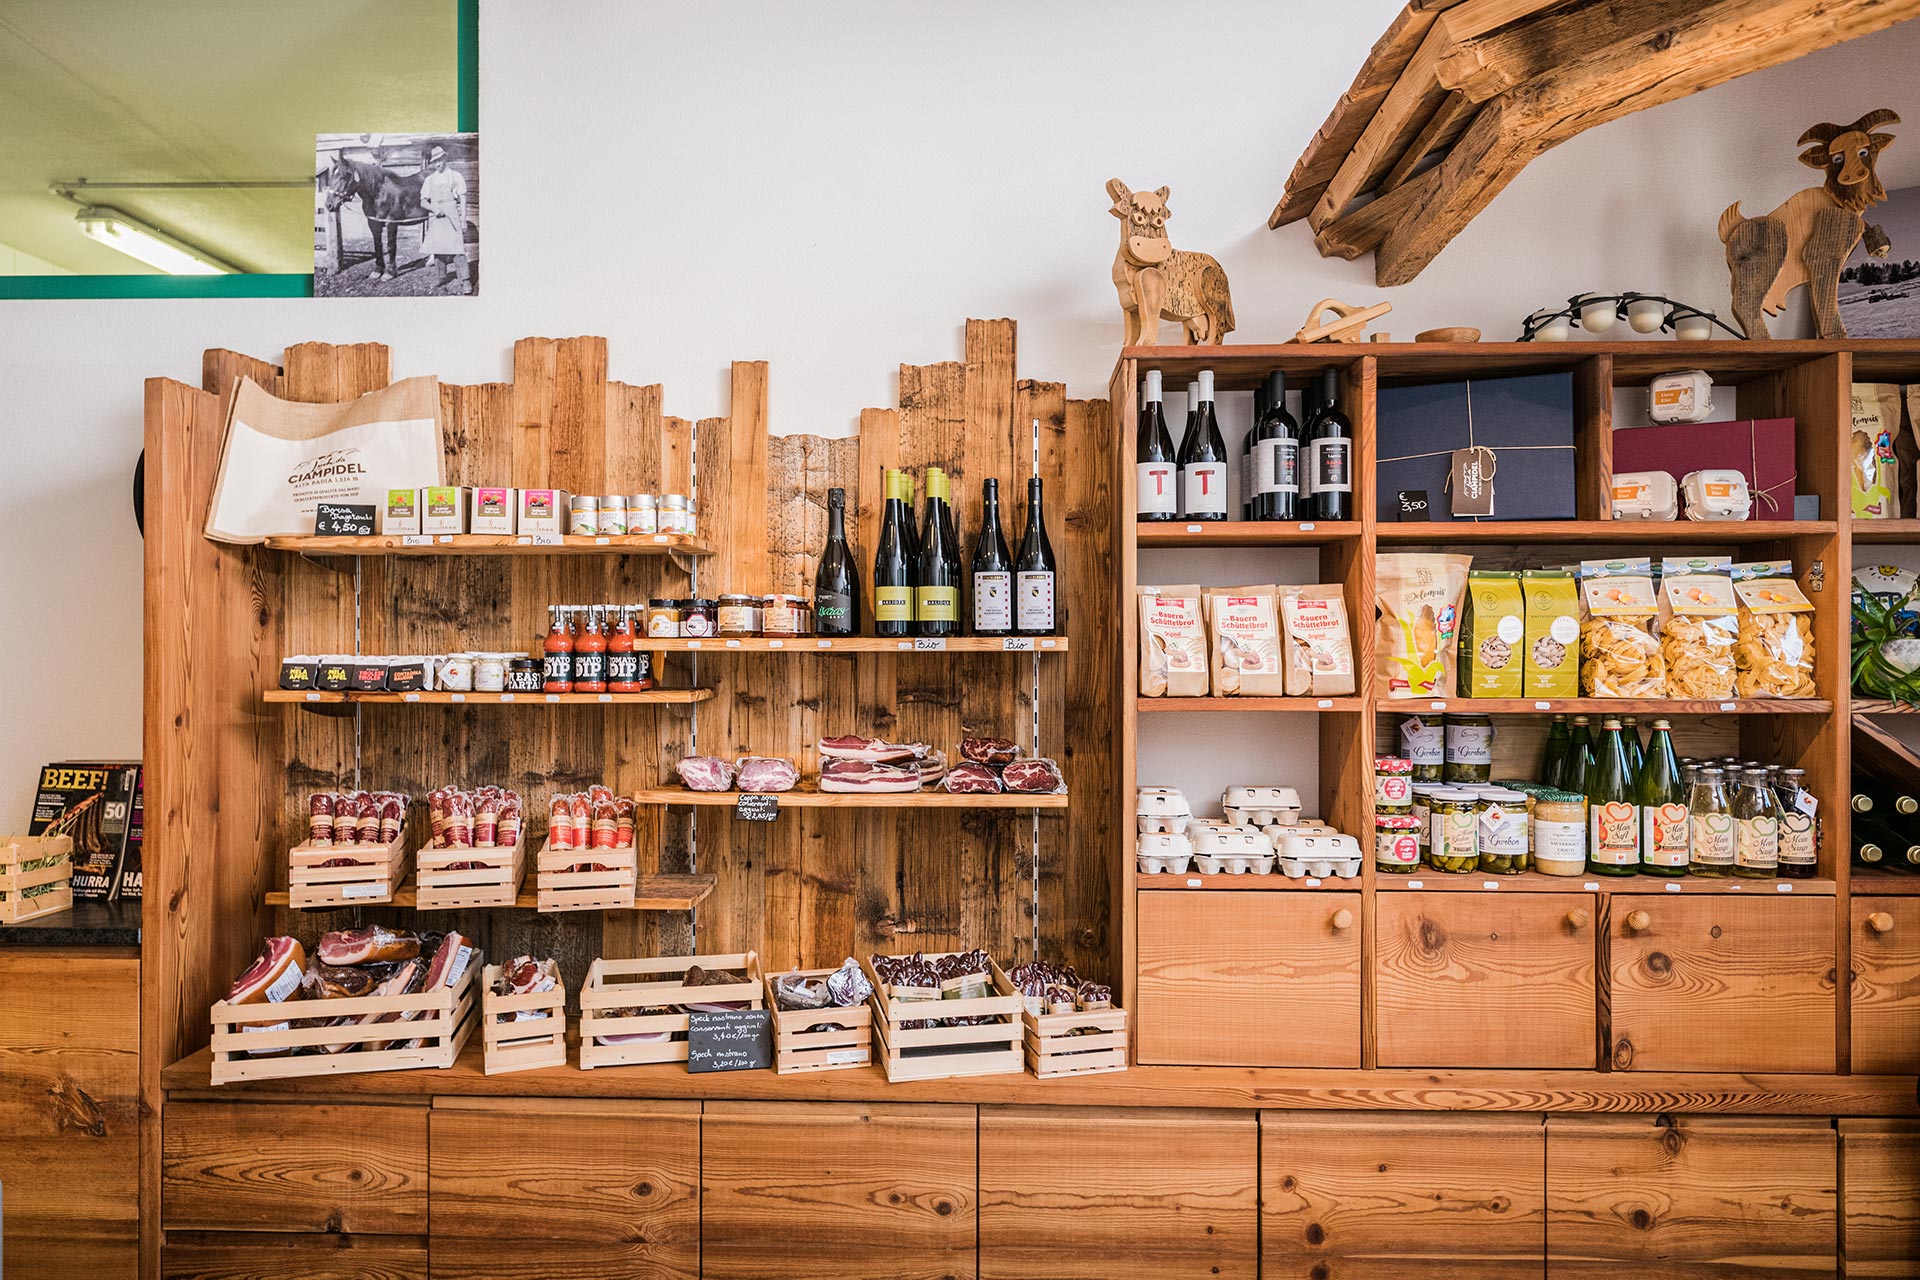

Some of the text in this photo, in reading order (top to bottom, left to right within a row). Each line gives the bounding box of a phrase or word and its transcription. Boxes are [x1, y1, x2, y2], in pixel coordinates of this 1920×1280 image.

[288, 463, 366, 484] CIAMPIDEL
[1148, 470, 1168, 496] T
[1194, 470, 1215, 496] T
[1399, 492, 1408, 501] €
[1401, 500, 1428, 512] 3,50
[318, 520, 358, 533] € 4,50
[406, 536, 420, 544] Bio
[536, 535, 552, 544] Bio
[1150, 617, 1194, 626] Schüttelbrot
[1158, 612, 1184, 620] Bauern
[1300, 614, 1328, 622] Bauern
[1293, 620, 1340, 628] Schüttelbrot
[916, 638, 940, 649] Bio
[1005, 638, 1028, 650] Bio
[544, 662, 570, 677] DIP
[576, 662, 602, 677] DIP
[609, 662, 636, 677] DIP
[42, 768, 109, 791] BEEF!
[104, 802, 126, 819] 50
[1610, 822, 1630, 832] Mein
[1665, 824, 1684, 834] Mein
[72, 875, 110, 888] HURRA
[690, 1014, 710, 1024] Speck
[690, 1048, 748, 1062] Speck nostrano
